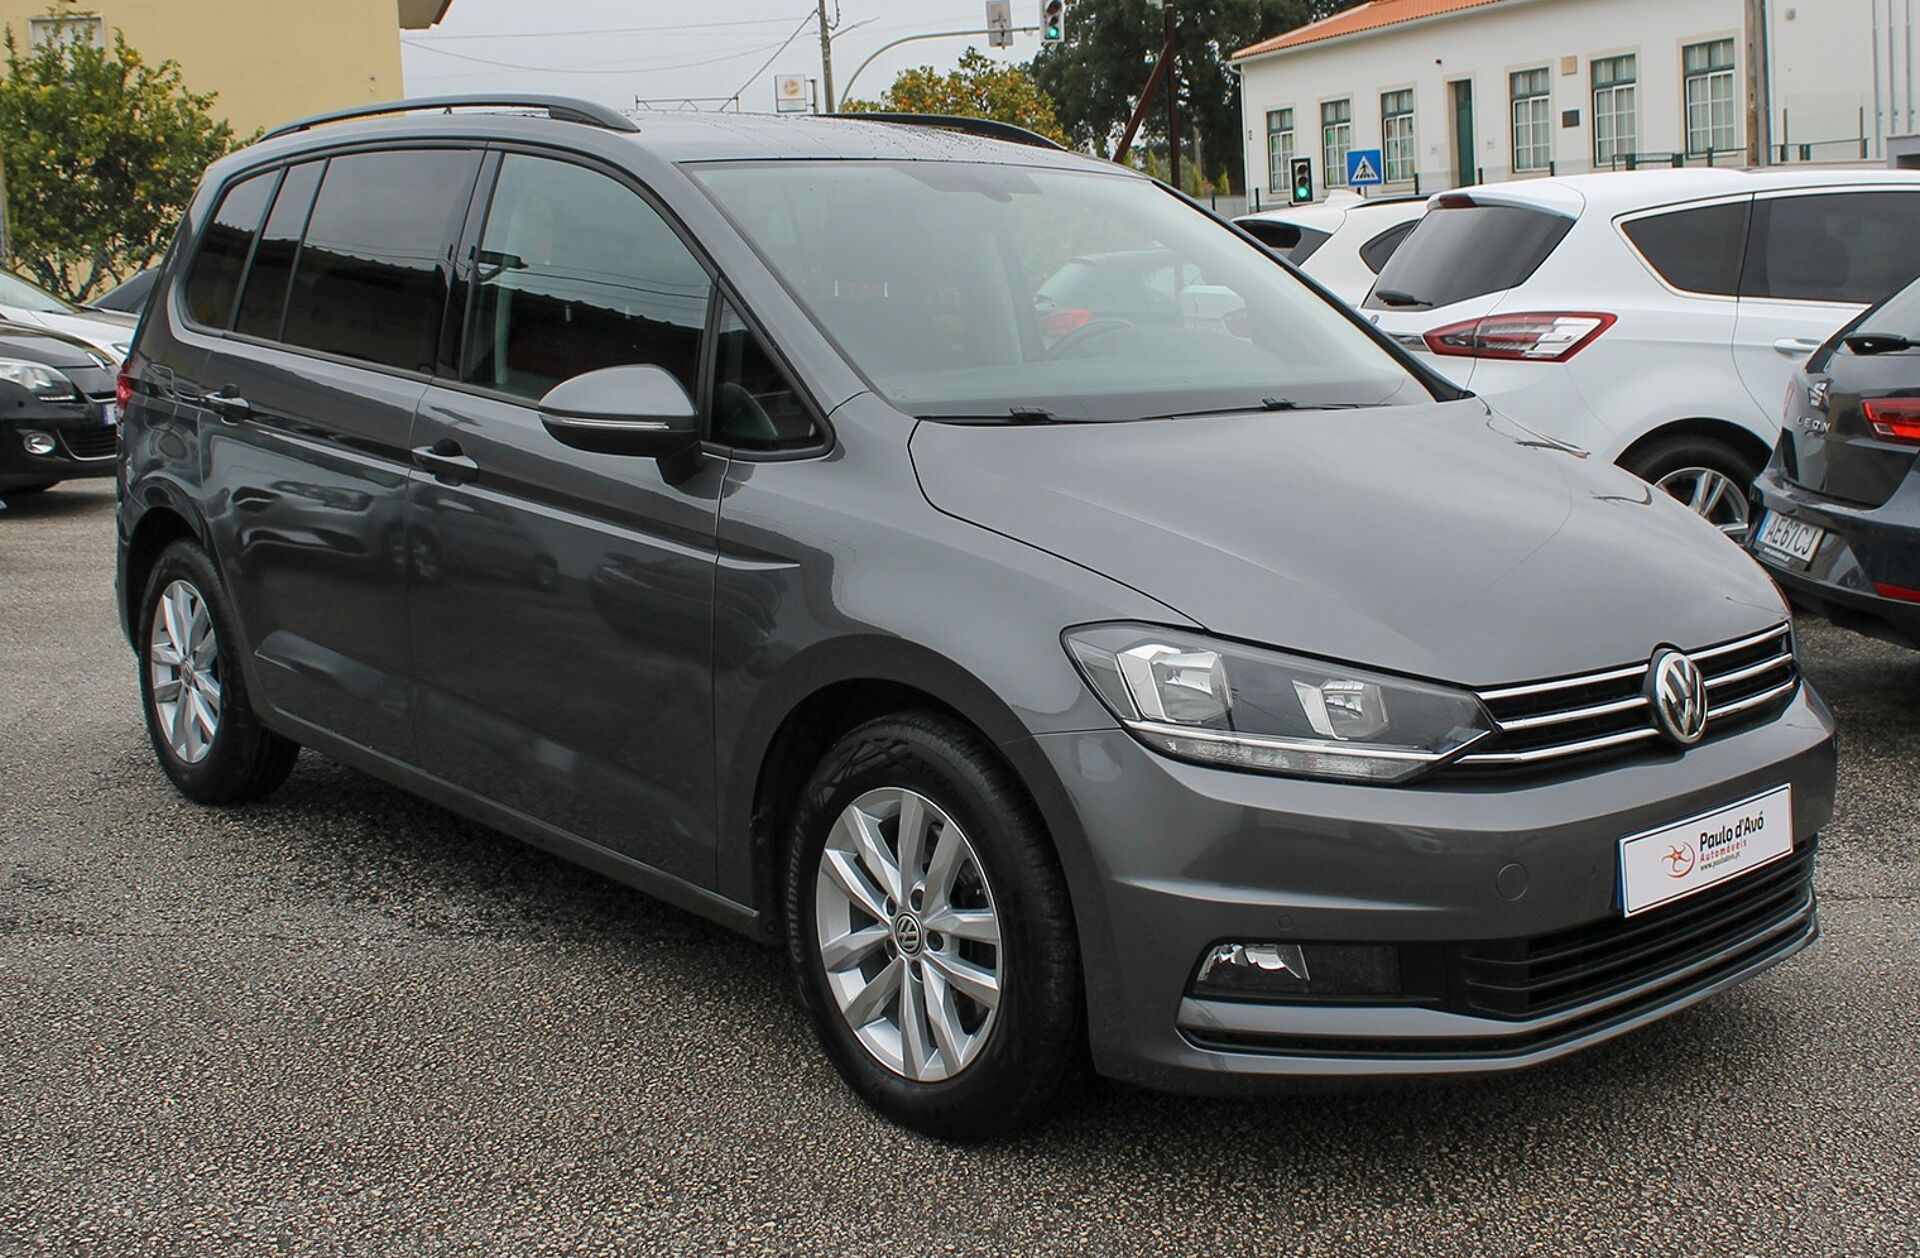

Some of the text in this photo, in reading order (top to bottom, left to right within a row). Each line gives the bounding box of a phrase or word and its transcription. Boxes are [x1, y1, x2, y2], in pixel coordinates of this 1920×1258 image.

[1765, 515, 1818, 556] AE67CJ
[1700, 810, 1764, 852] Paulo d'Avó
